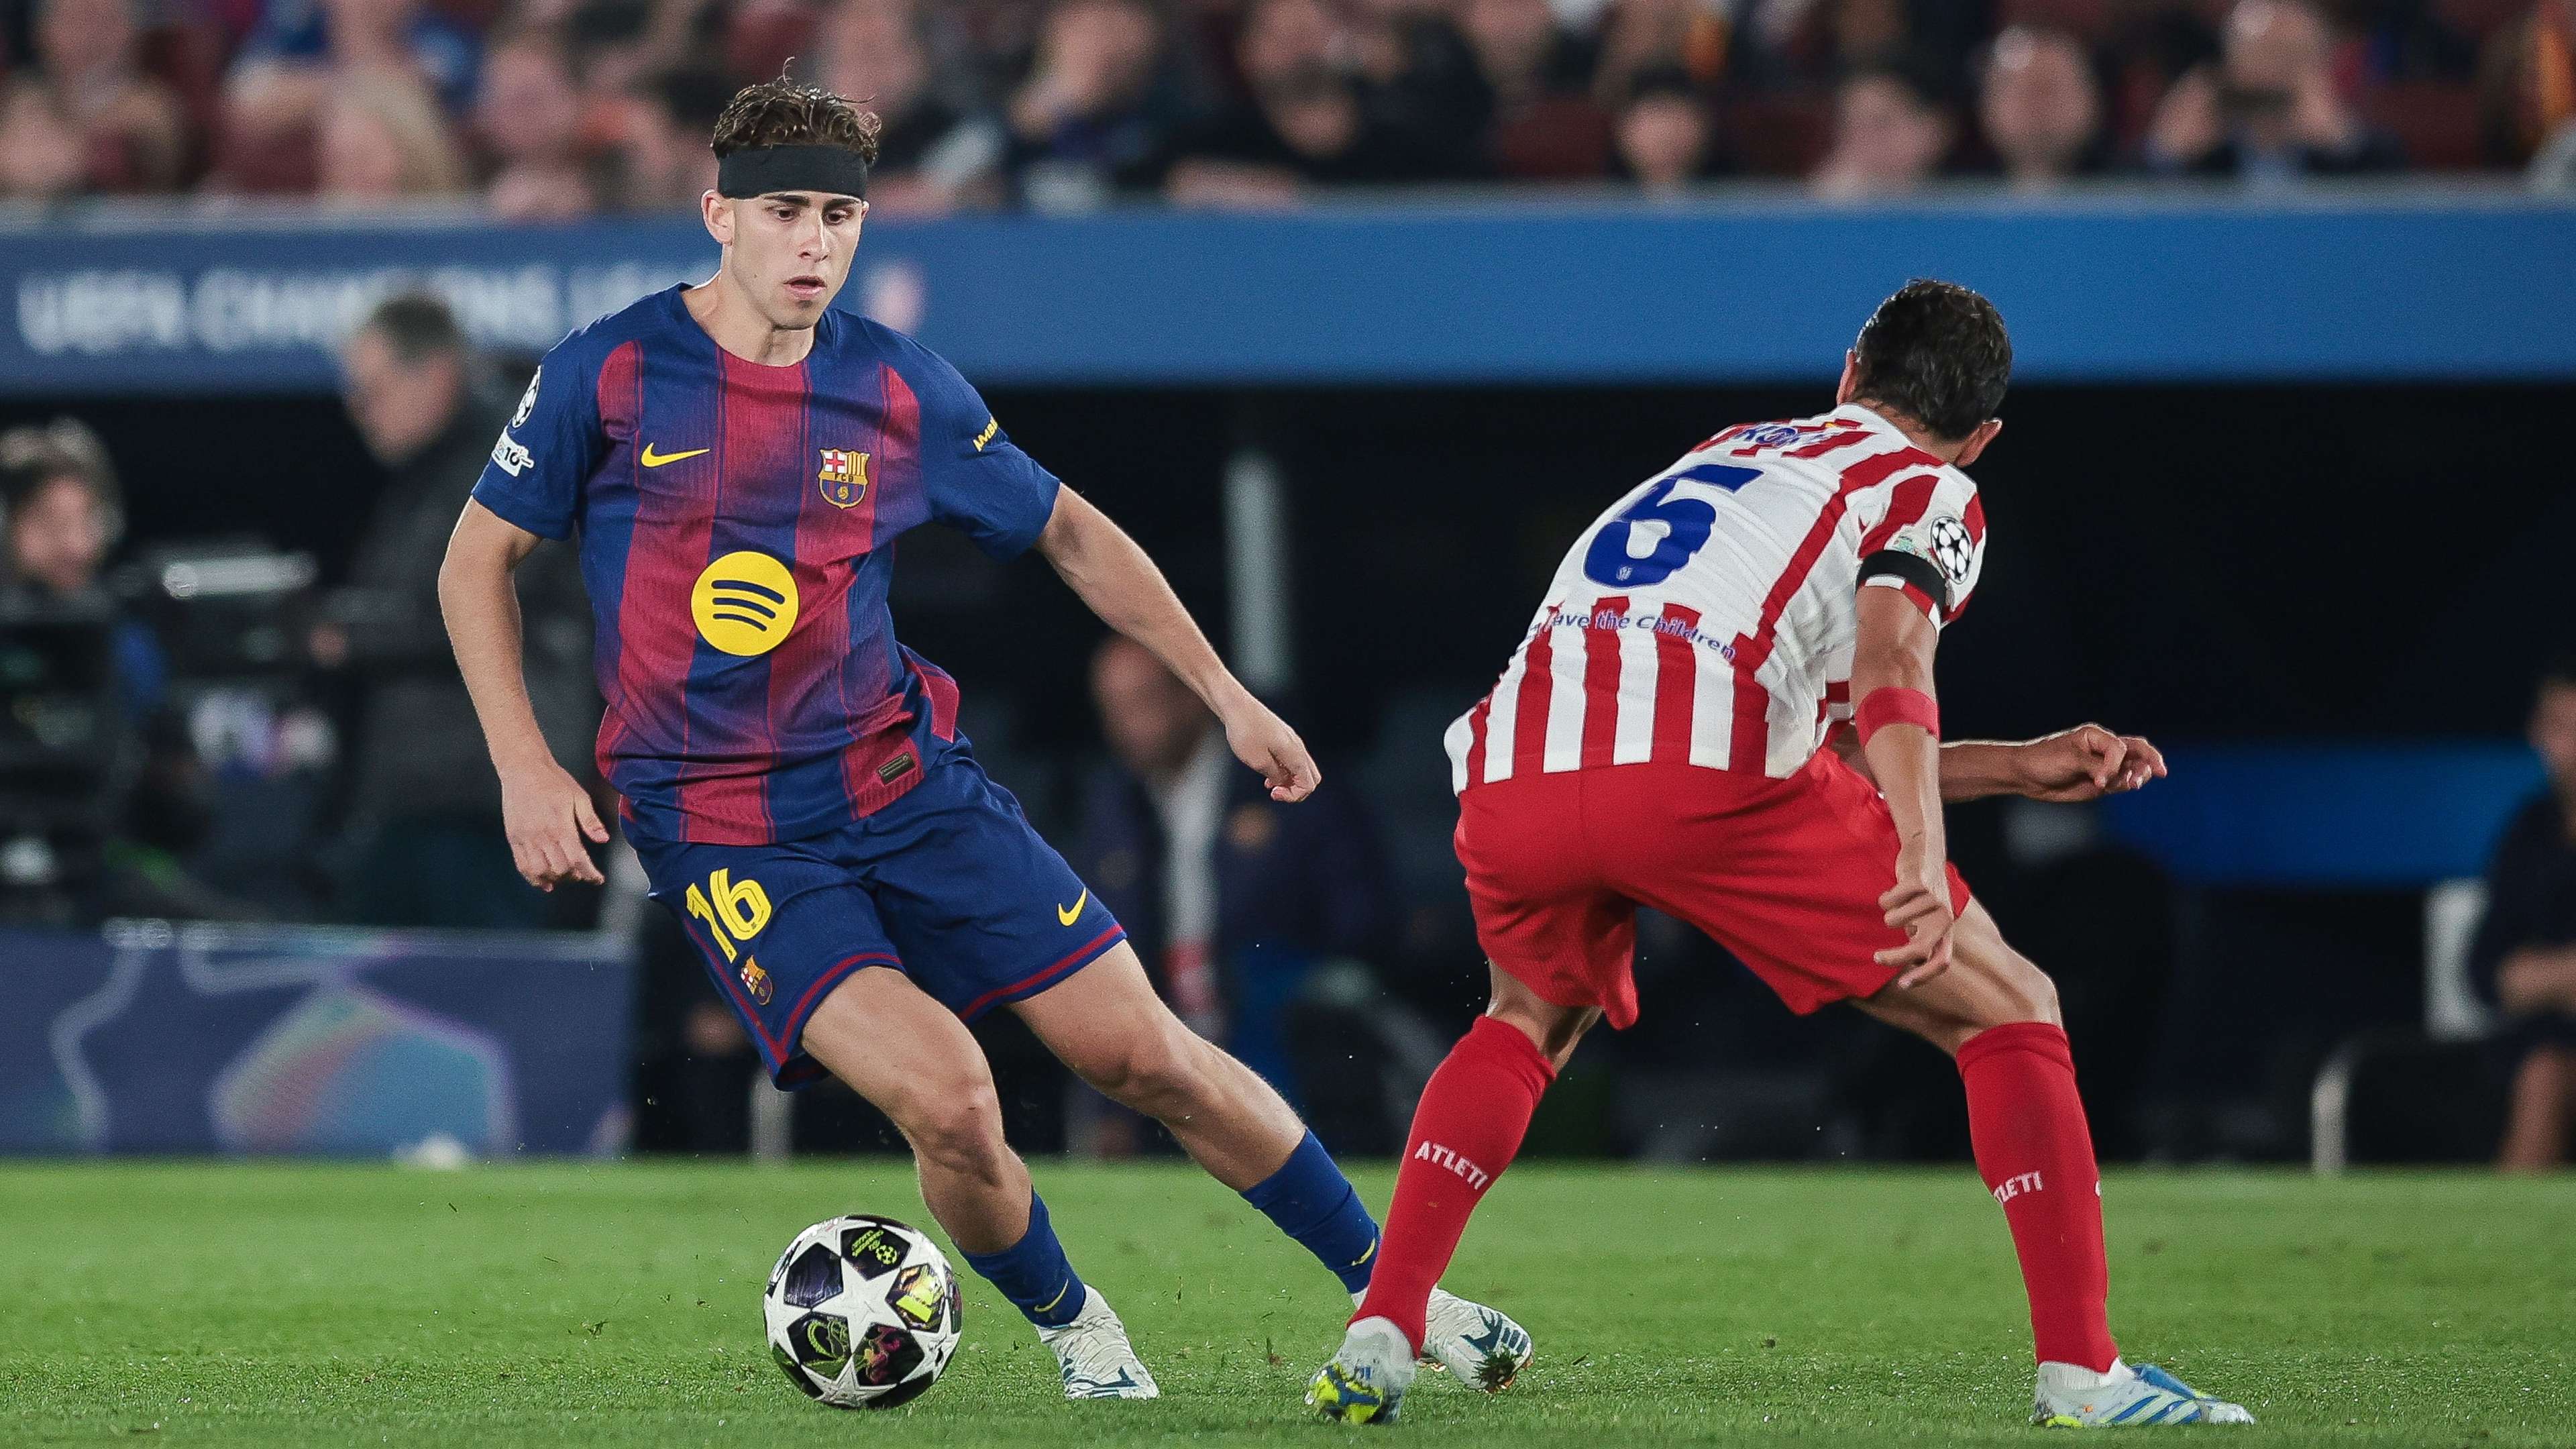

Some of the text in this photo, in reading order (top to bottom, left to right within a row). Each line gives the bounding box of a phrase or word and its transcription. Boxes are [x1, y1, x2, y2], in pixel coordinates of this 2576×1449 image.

[835, 473, 854, 482] FCB
[1583, 464, 1764, 588] 6
[1595, 609, 1630, 630] the
[1636, 614, 1735, 660] Children
[686, 867, 772, 963] 16
[1414, 1140, 1489, 1190] ATLETI
